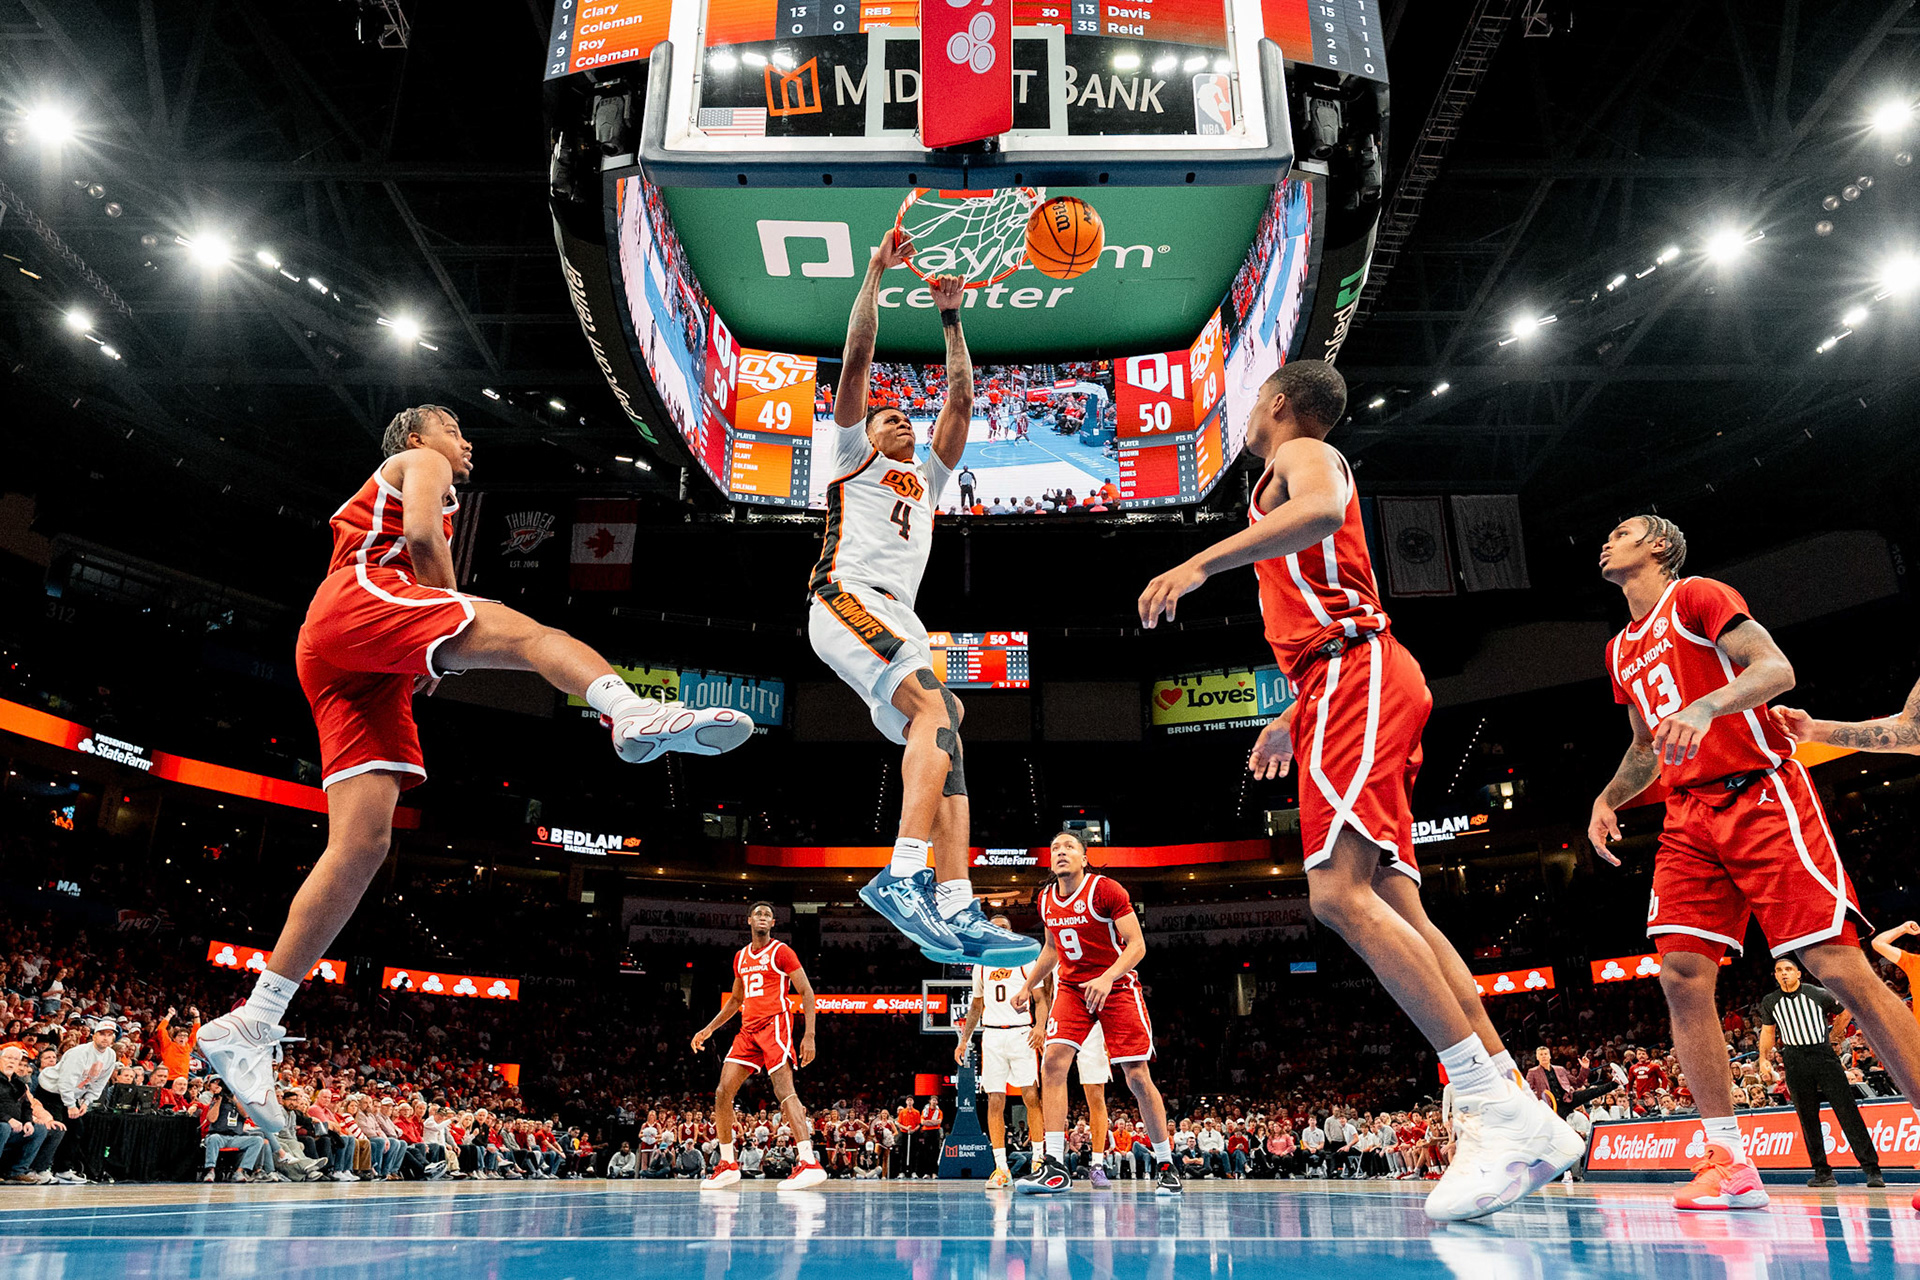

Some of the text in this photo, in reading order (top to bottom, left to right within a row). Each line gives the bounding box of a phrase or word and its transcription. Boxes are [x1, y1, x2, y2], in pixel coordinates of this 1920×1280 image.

[562, 4, 618, 24] 1 Clary
[790, 4, 845, 17] 13 0
[865, 8, 891, 16] REB
[1042, 8, 1059, 17] 30
[1078, 4, 1151, 20] 13 Davis
[1320, 6, 1366, 26] 15 1
[558, 15, 642, 40] 4 Coleman
[792, 21, 844, 34] 0 0
[1077, 21, 1097, 32] 35
[1108, 23, 1144, 36] Reid
[1324, 22, 1368, 42] 9 1
[556, 38, 606, 57] 9 Roy
[1327, 39, 1370, 58] 2 1
[551, 48, 638, 74] 21 Coleman
[1329, 54, 1374, 73] 5 0
[1202, 124, 1220, 135] NBA
[713, 366, 728, 410] 50
[1203, 372, 1216, 410] 49
[758, 400, 792, 430] 49
[1139, 401, 1172, 432] 50
[736, 432, 756, 440] PLAYER
[1120, 440, 1139, 448] PLAYER
[1120, 450, 1139, 458] BROWN
[734, 462, 758, 470] COLEMAN
[732, 483, 756, 491] COLEMAN
[504, 510, 555, 531] THUNDER
[890, 500, 912, 540] 4
[832, 592, 884, 640] COWBOYS
[929, 635, 946, 644] 49
[990, 634, 1008, 644] 50
[1621, 638, 1673, 681] OKLAHOMA
[684, 682, 780, 719] LOUD CITY
[1187, 688, 1255, 708] Loves
[1632, 662, 1682, 730] 13
[582, 710, 601, 719] BRI
[1168, 716, 1278, 734] BRING THE THUNDE
[95, 733, 144, 755] PRESENTED BY
[1411, 815, 1469, 837] EDLAM
[550, 828, 623, 850] BEDLAM
[564, 844, 607, 856] BASKETBALL
[639, 908, 663, 921] POST
[677, 912, 696, 924] OAK
[700, 912, 730, 925] PARTY
[1047, 915, 1088, 927] OKLAHOMA
[1162, 909, 1301, 928] POST OAK PARTY TERRACE
[1059, 928, 1083, 960] 9
[741, 965, 768, 974] OKLAHOMA
[743, 973, 764, 998] 12
[995, 985, 1006, 1002] 0
